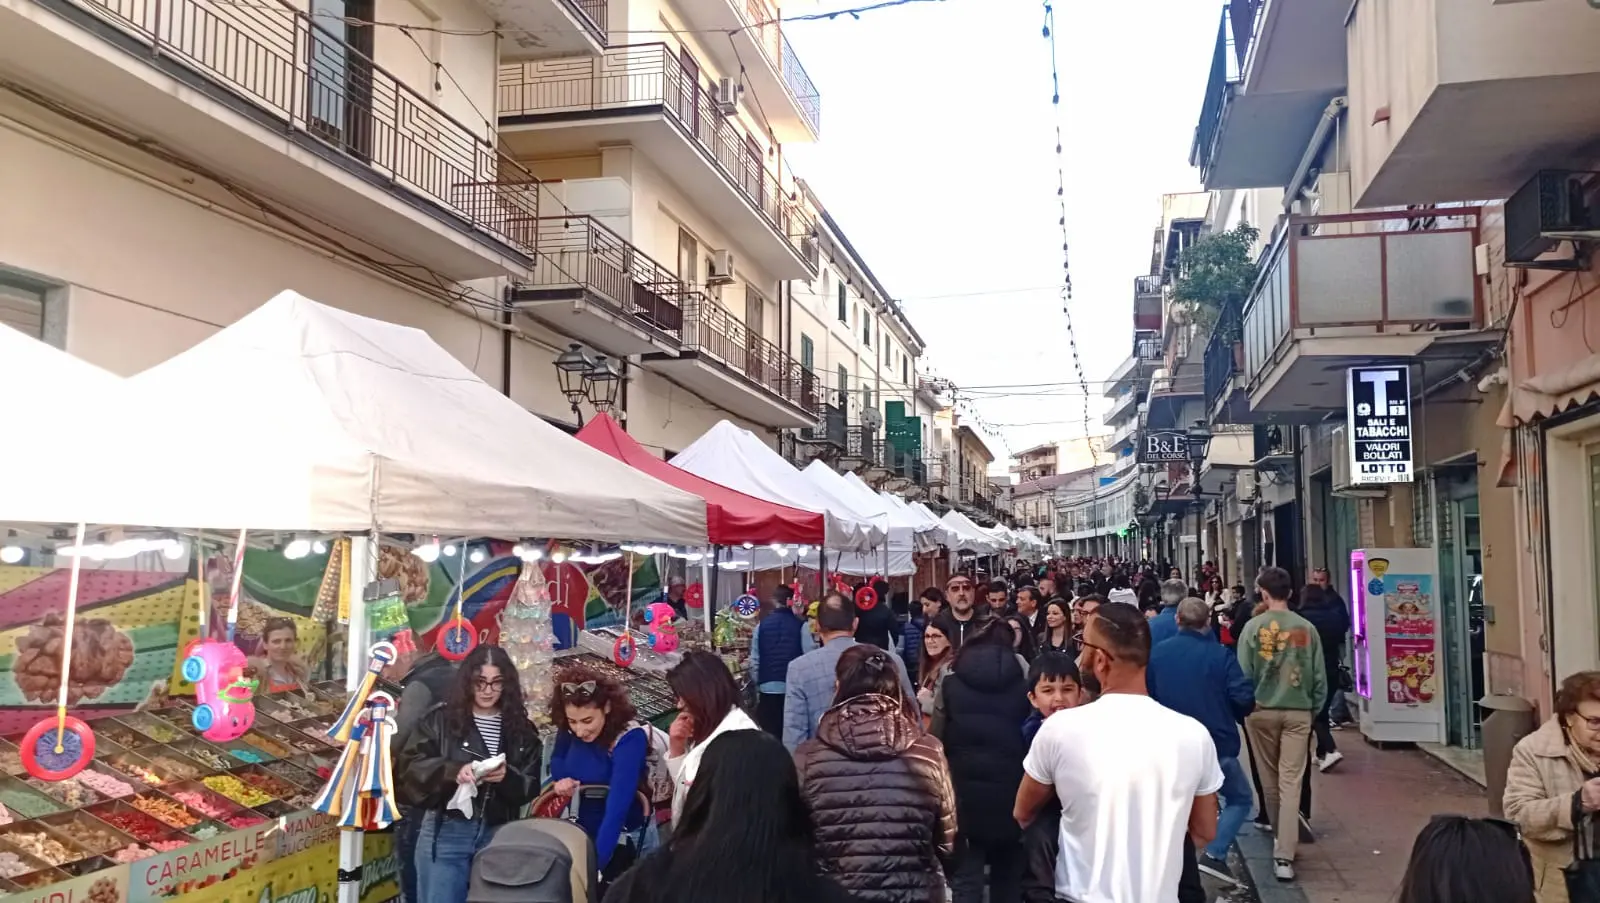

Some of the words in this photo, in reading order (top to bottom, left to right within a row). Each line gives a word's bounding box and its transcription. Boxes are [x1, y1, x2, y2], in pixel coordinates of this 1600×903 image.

[1360, 370, 1399, 416] T
[1389, 418, 1396, 426] E
[1356, 426, 1408, 437] TABACCHI
[1365, 442, 1400, 451] VALORI
[1363, 451, 1402, 460] BOLLATI
[1361, 463, 1406, 473] LOTTO
[146, 830, 265, 886] CARAMELLE
